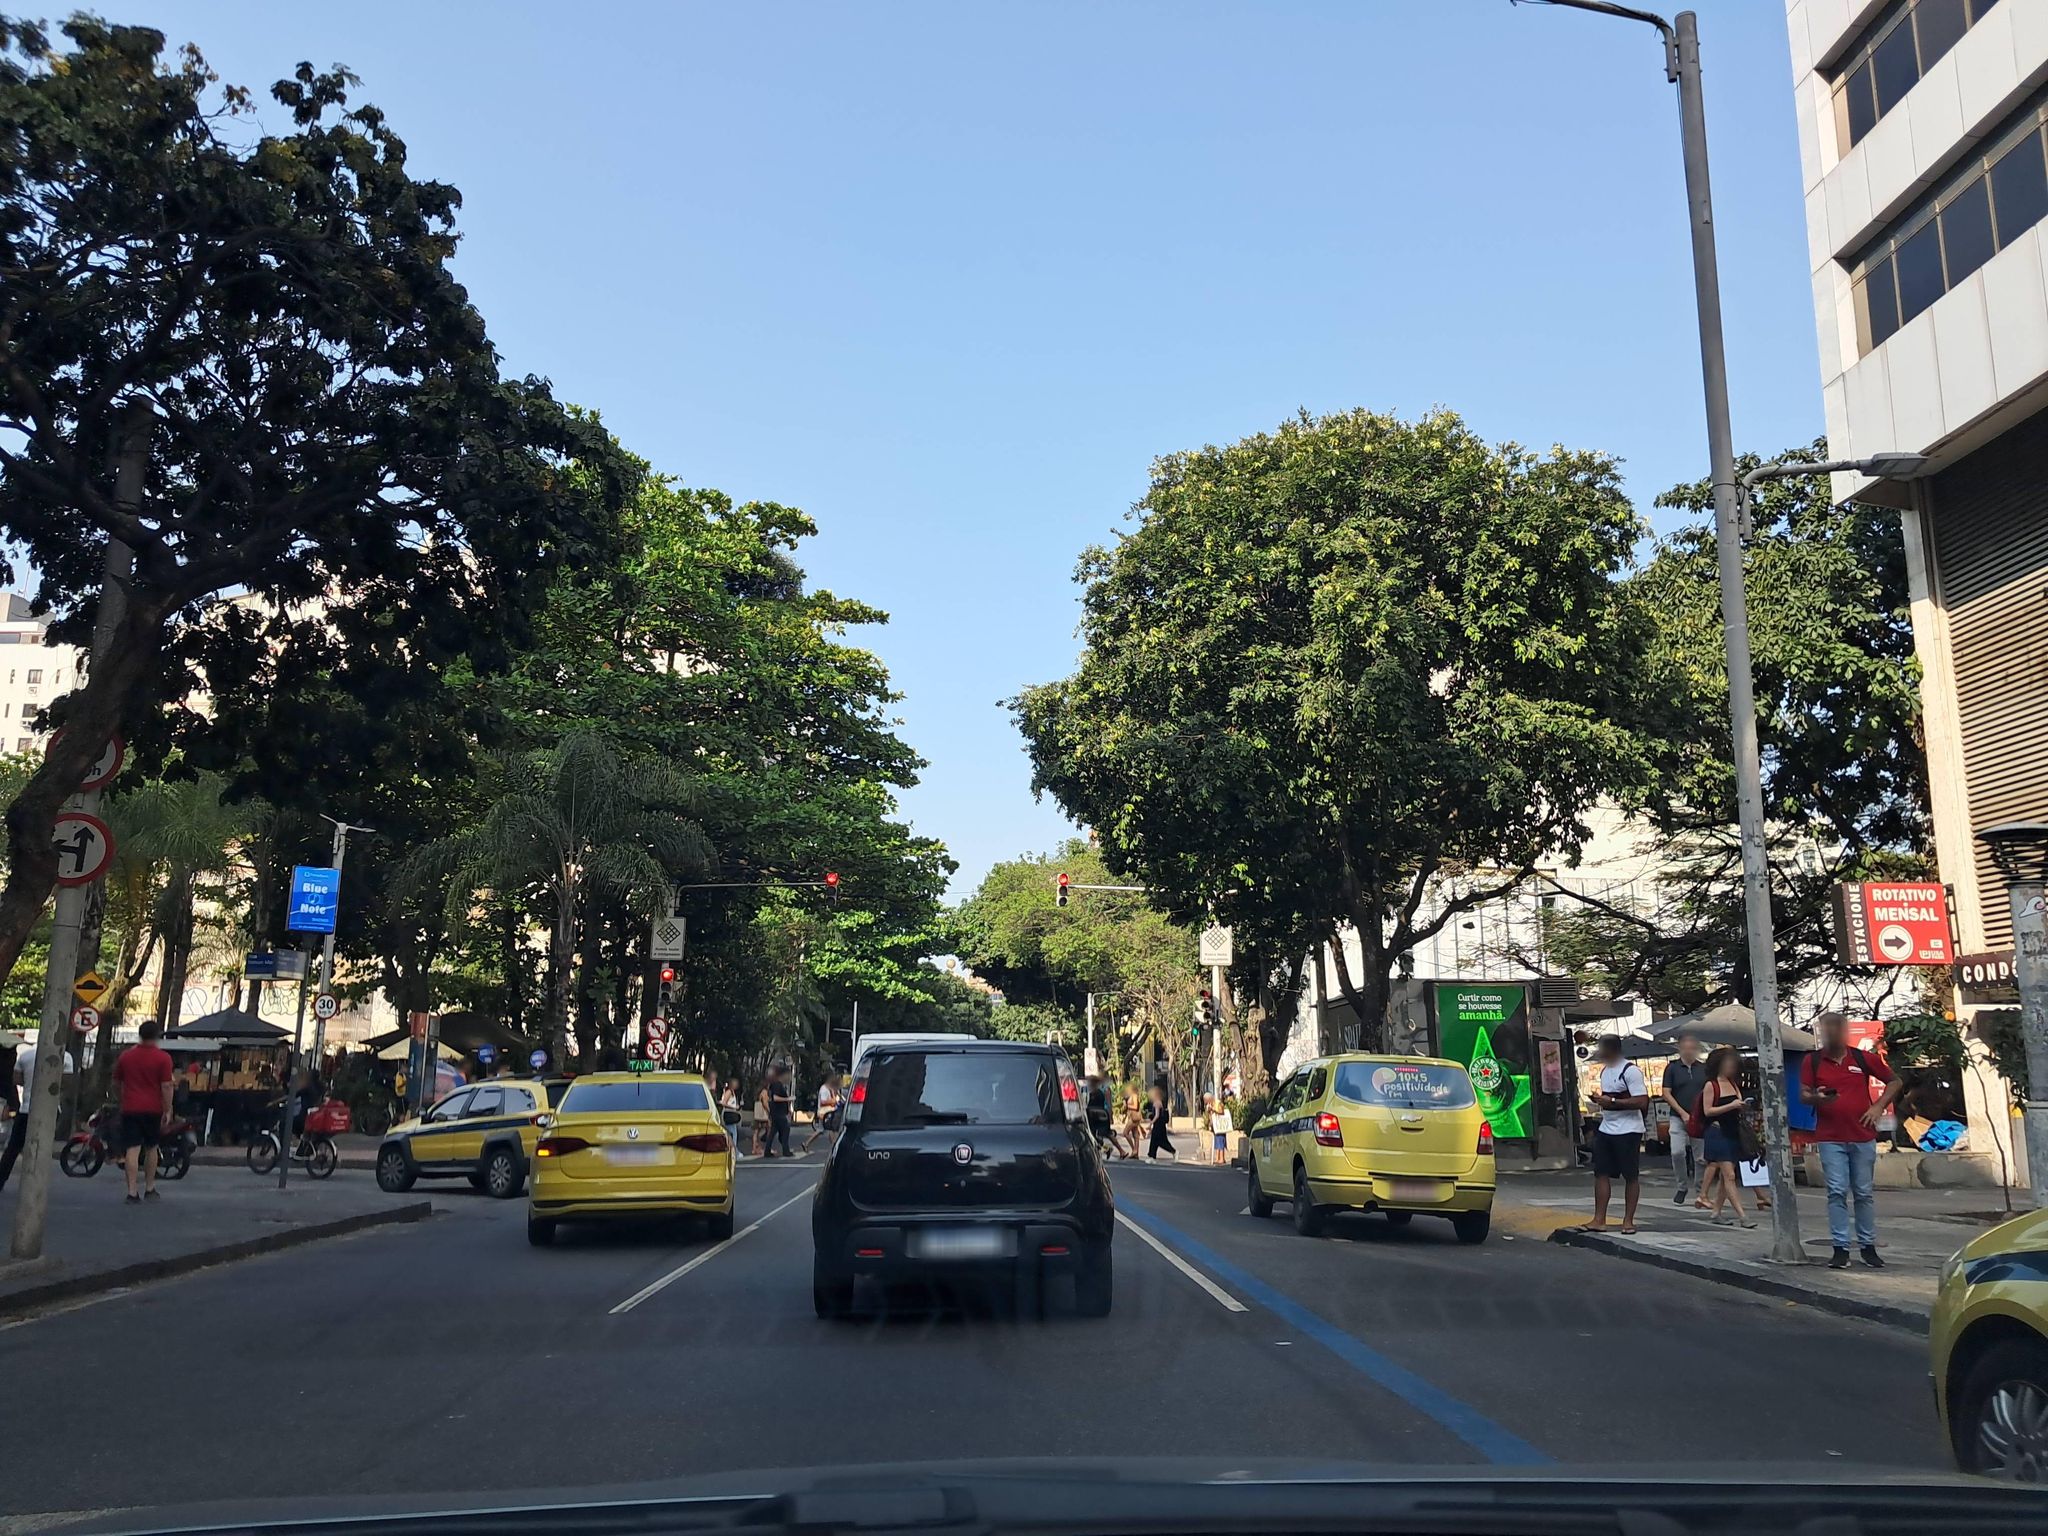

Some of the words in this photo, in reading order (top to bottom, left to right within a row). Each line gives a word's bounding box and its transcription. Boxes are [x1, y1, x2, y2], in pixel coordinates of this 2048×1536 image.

[302, 883, 329, 894] Blue
[1872, 888, 1937, 902] ROTATIVO
[300, 903, 326, 915] Note
[1874, 907, 1940, 921] MENSAL
[1847, 882, 1869, 963] ESTACIONE
[1457, 993, 1480, 1002] Curtir
[1481, 994, 1502, 1002] como
[318, 999, 334, 1010] 30
[1468, 1002, 1502, 1010] houvesse
[1459, 1010, 1506, 1020] amanhã.
[629, 1060, 653, 1071] TAXI
[1383, 1081, 1449, 1095] positividade
